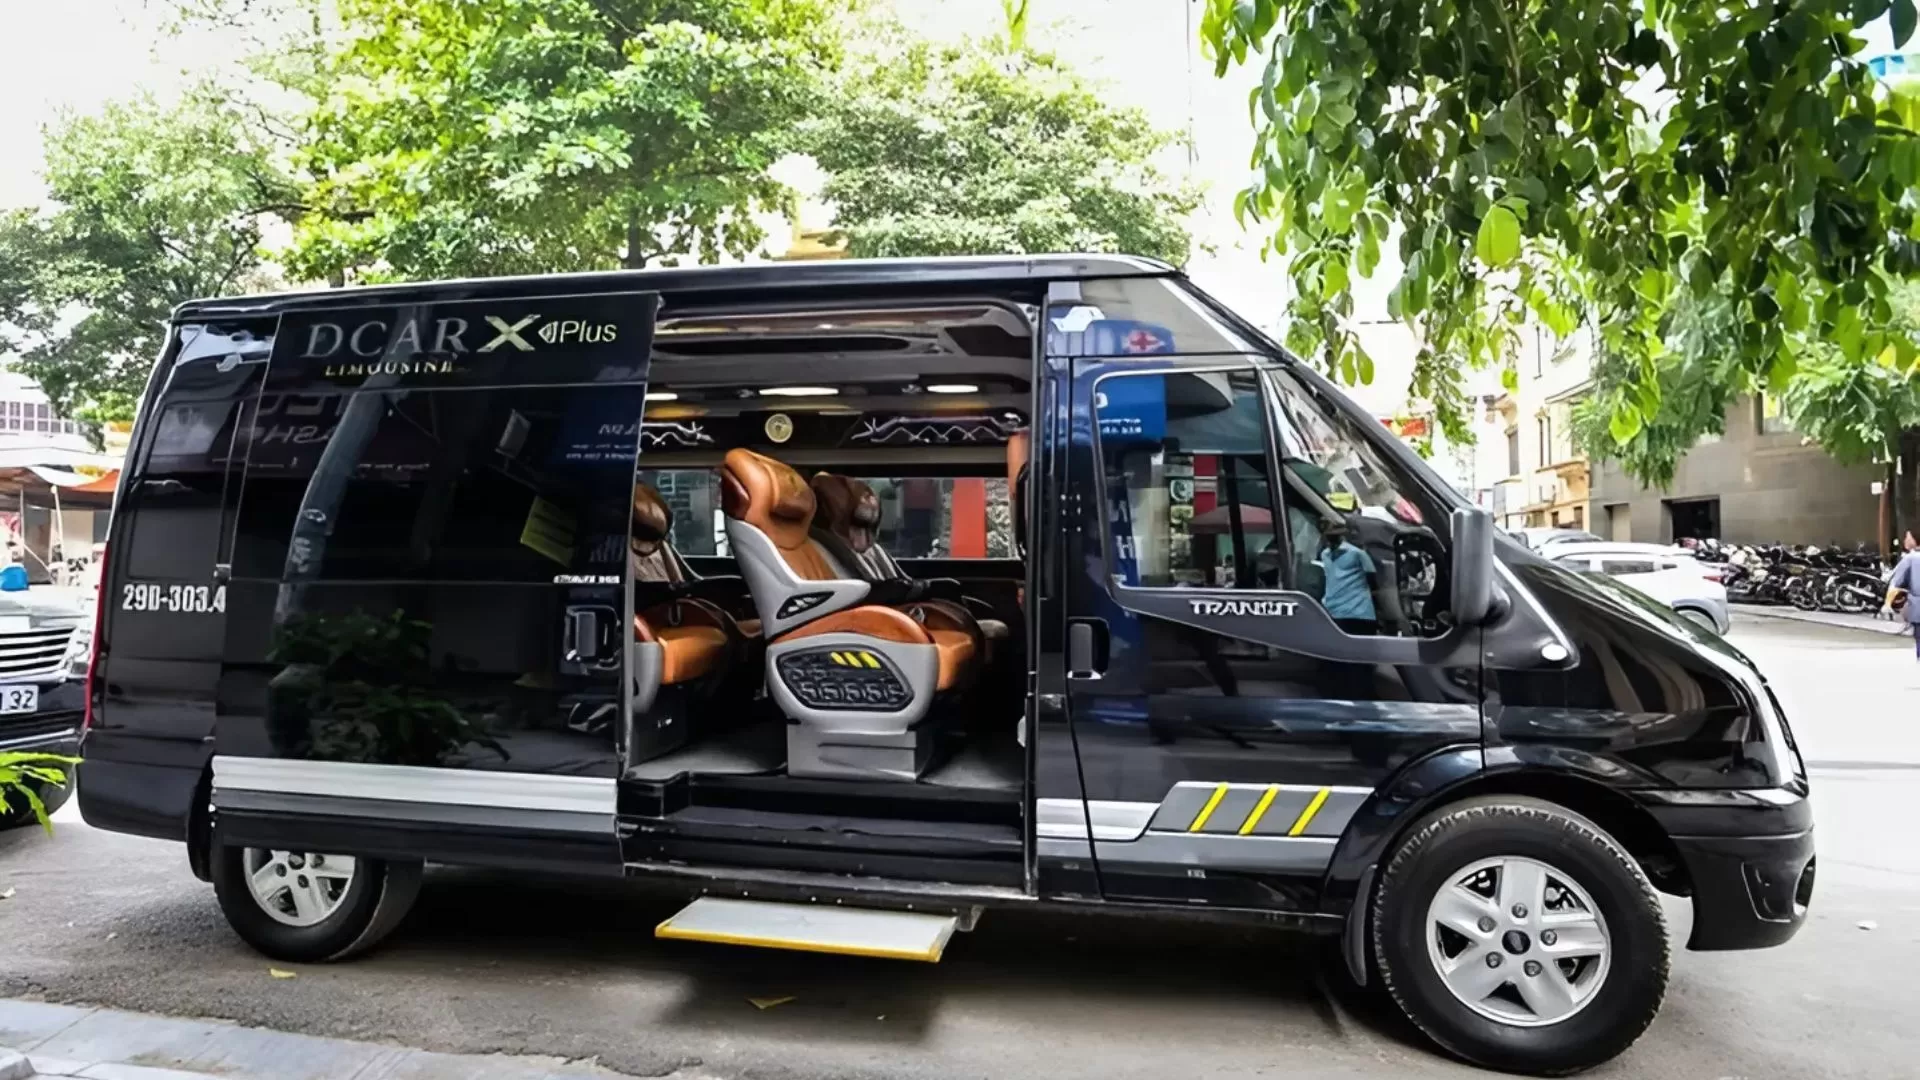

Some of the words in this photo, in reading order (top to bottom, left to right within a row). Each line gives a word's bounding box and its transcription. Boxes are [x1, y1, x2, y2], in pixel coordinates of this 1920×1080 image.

[300, 317, 469, 358] DCAR
[476, 314, 541, 352] X
[560, 320, 617, 343] Plus
